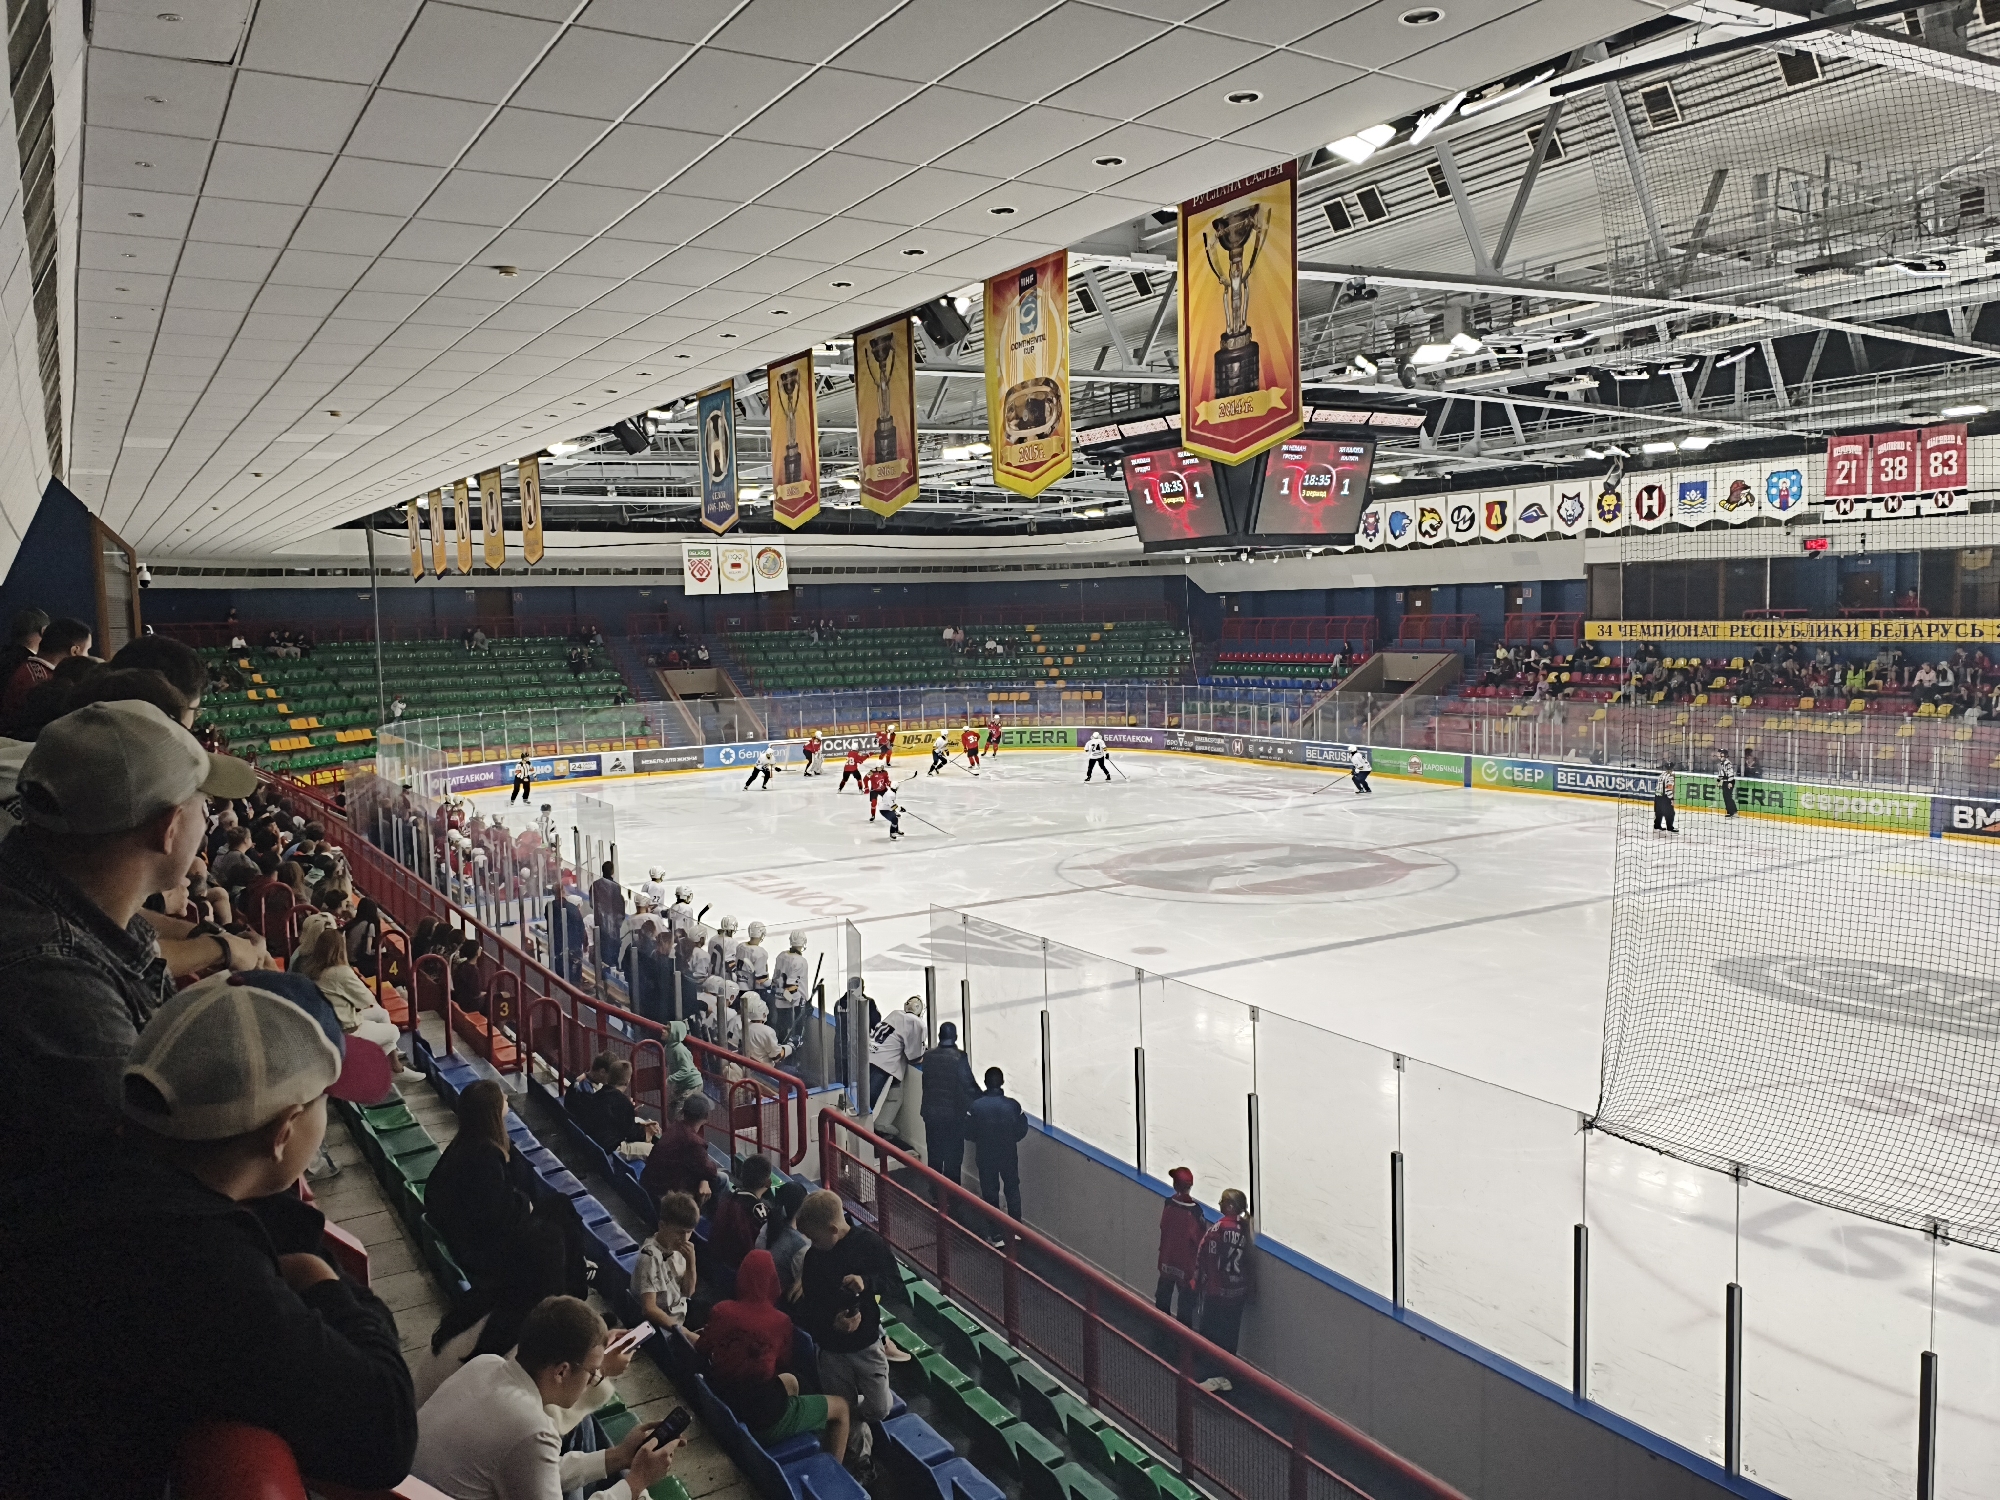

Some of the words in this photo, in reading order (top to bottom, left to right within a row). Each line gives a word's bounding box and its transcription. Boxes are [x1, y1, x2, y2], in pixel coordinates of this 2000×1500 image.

[1023, 345, 1035, 355] CUP
[1219, 398, 1243, 418] 2014
[1018, 444, 1038, 462] 2015
[1836, 459, 1857, 484] 21
[1880, 456, 1908, 481] 38
[1930, 450, 1958, 477] 83
[1160, 480, 1184, 493] 18:35
[1280, 477, 1290, 495] 1
[1303, 474, 1332, 486] 18:35
[1340, 478, 1350, 496] 1
[1143, 488, 1153, 504] 1
[1193, 481, 1204, 498] 1
[1597, 624, 1613, 637] 34
[1618, 624, 1719, 639] ЧЕМПИОНАТ
[1729, 624, 1860, 639] РЕСПУБЛИКИ
[1870, 623, 1985, 638] БЕЛАРУСЬ
[902, 733, 933, 745] 105.0
[1104, 734, 1153, 744] БЕЛТЕЛЕКОМ
[1502, 766, 1545, 784] СБЕР
[1801, 792, 1917, 821] евроопт
[388, 960, 399, 976] 4
[499, 1002, 509, 1017] 3
